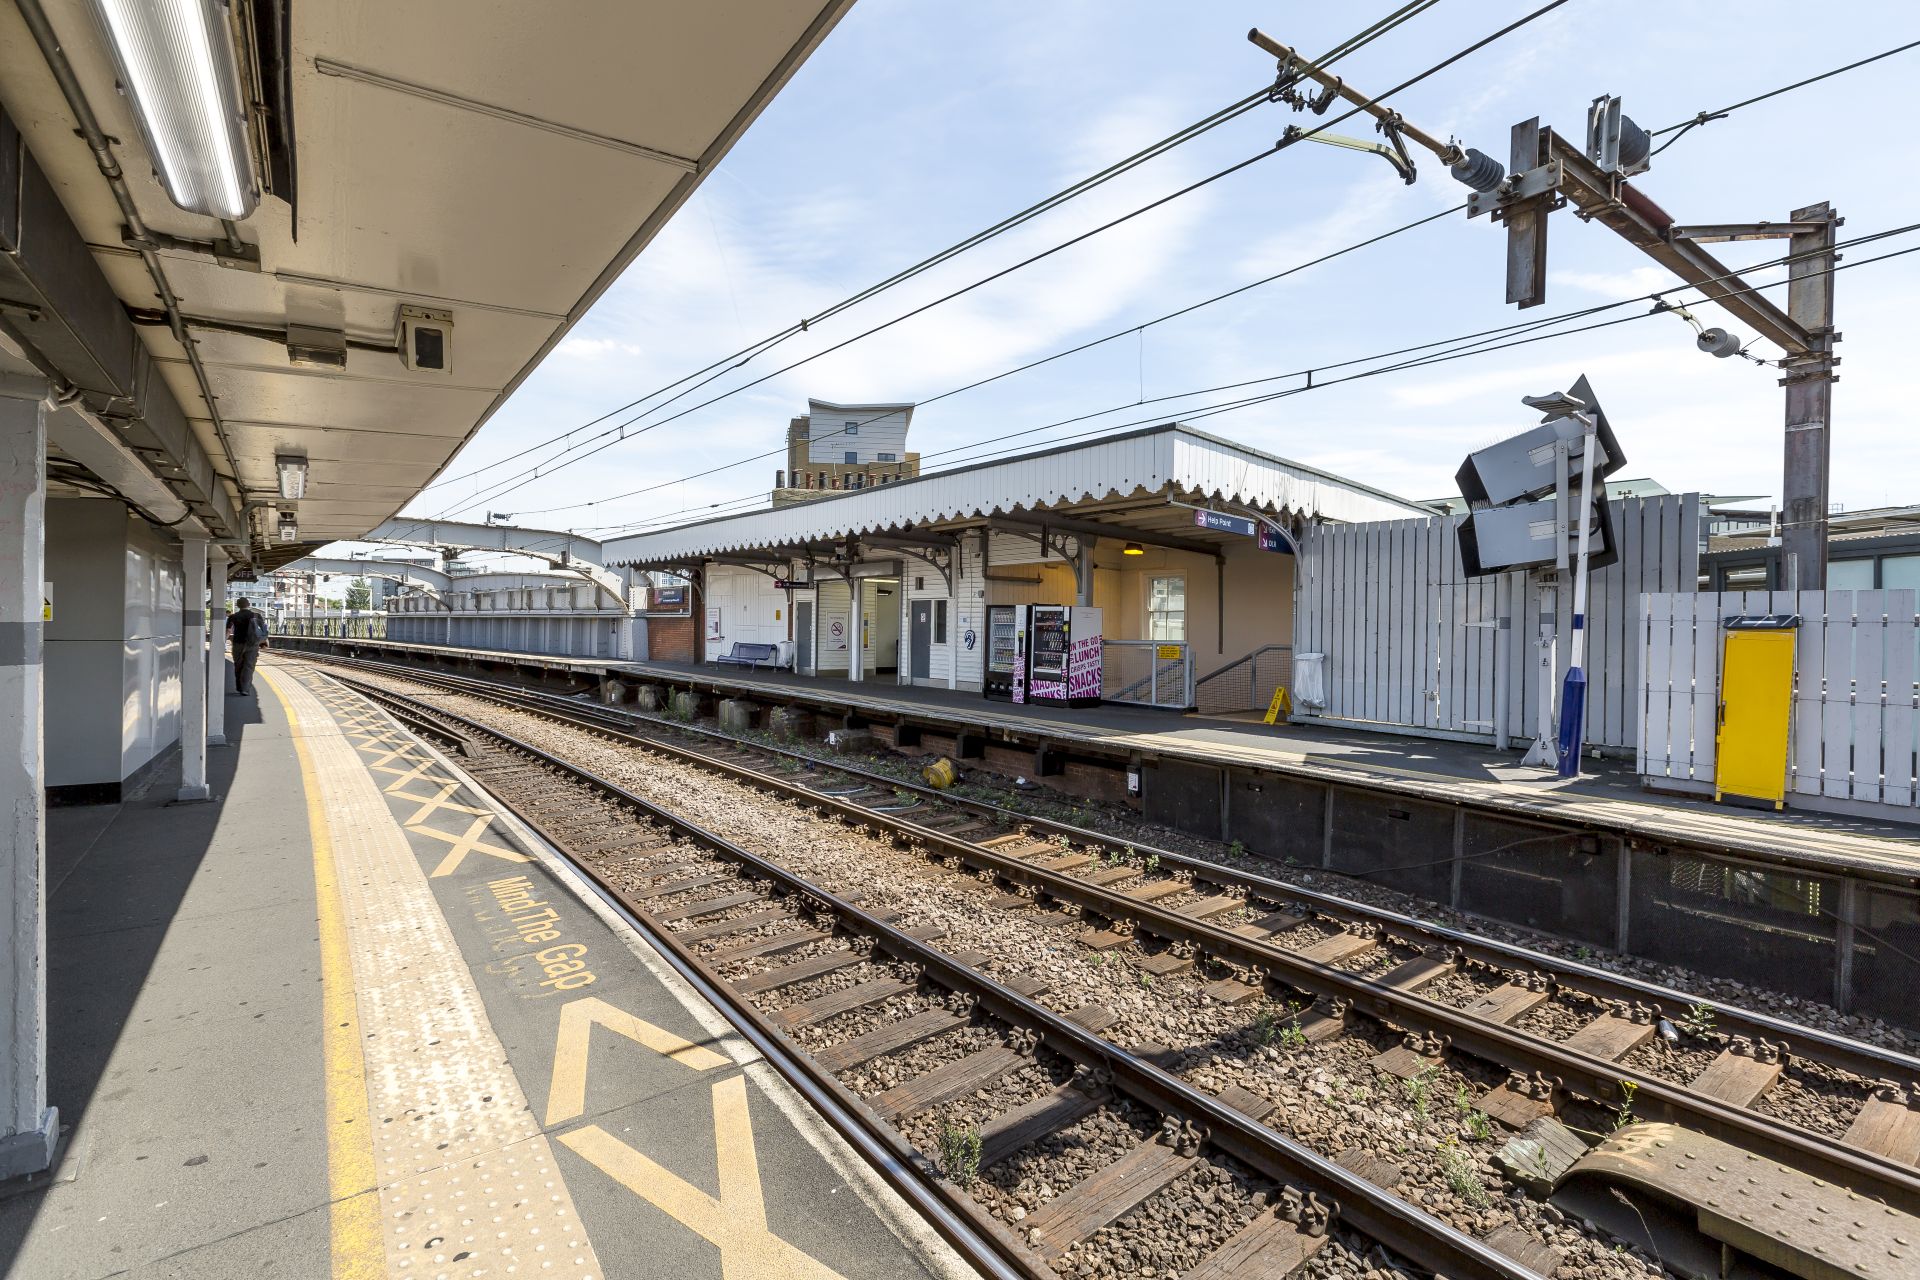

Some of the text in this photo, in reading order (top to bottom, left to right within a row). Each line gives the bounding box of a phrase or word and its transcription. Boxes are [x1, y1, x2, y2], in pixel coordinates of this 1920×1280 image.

[1207, 516, 1232, 527] Help Point
[1074, 646, 1100, 663] LUNCH
[1078, 639, 1089, 650] THE
[1090, 635, 1099, 647] GO
[1069, 666, 1101, 692] SNACKS
[487, 876, 548, 914] Mind
[511, 907, 561, 943] The
[535, 943, 597, 990] Gap
